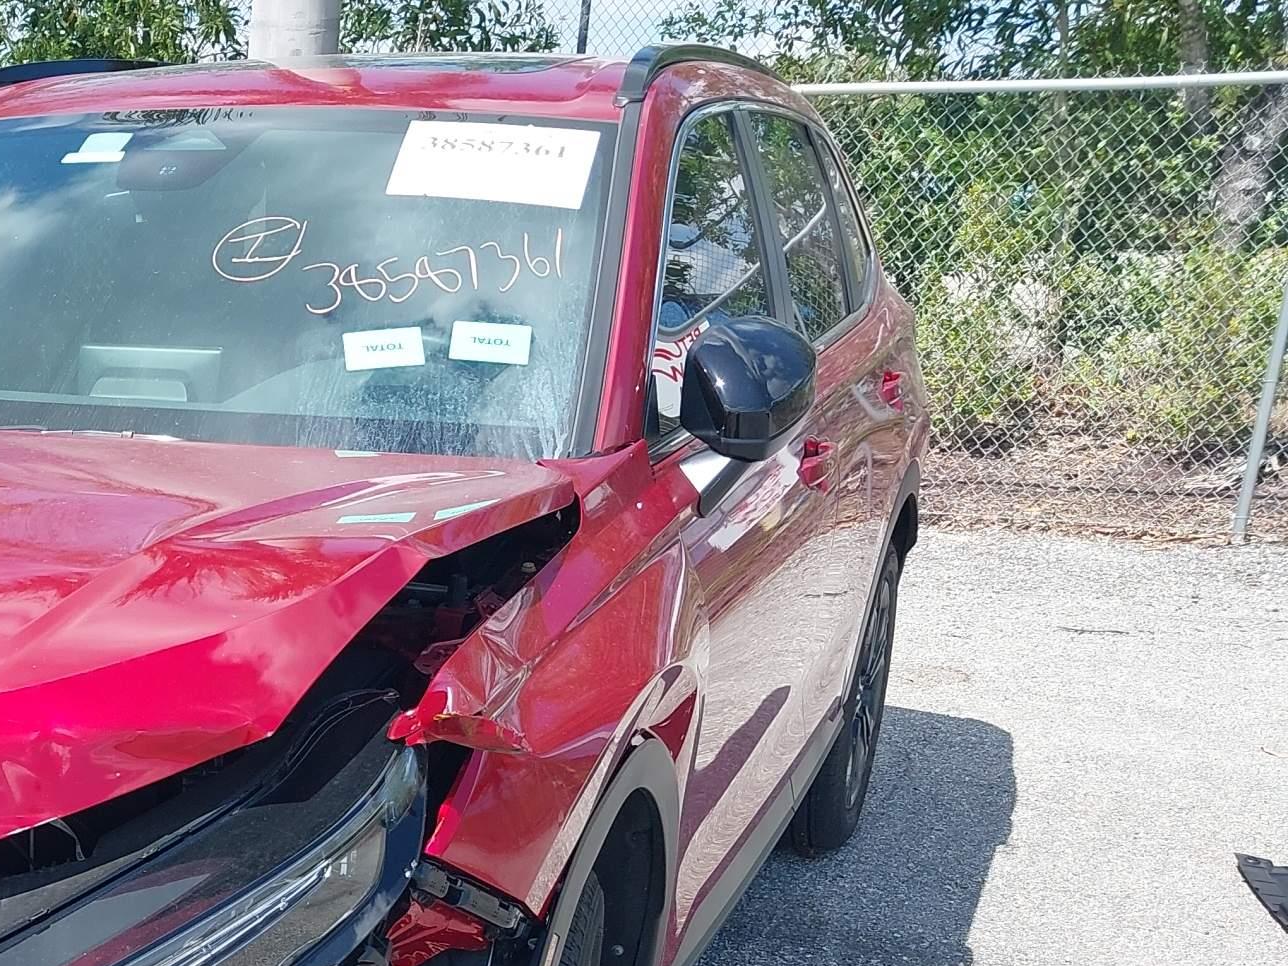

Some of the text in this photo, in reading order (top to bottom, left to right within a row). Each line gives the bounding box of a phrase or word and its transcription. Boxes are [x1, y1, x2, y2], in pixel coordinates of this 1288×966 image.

[302, 227, 563, 314] 38587361
[362, 341, 404, 353] TOTAL
[471, 336, 512, 347] TOTAL
